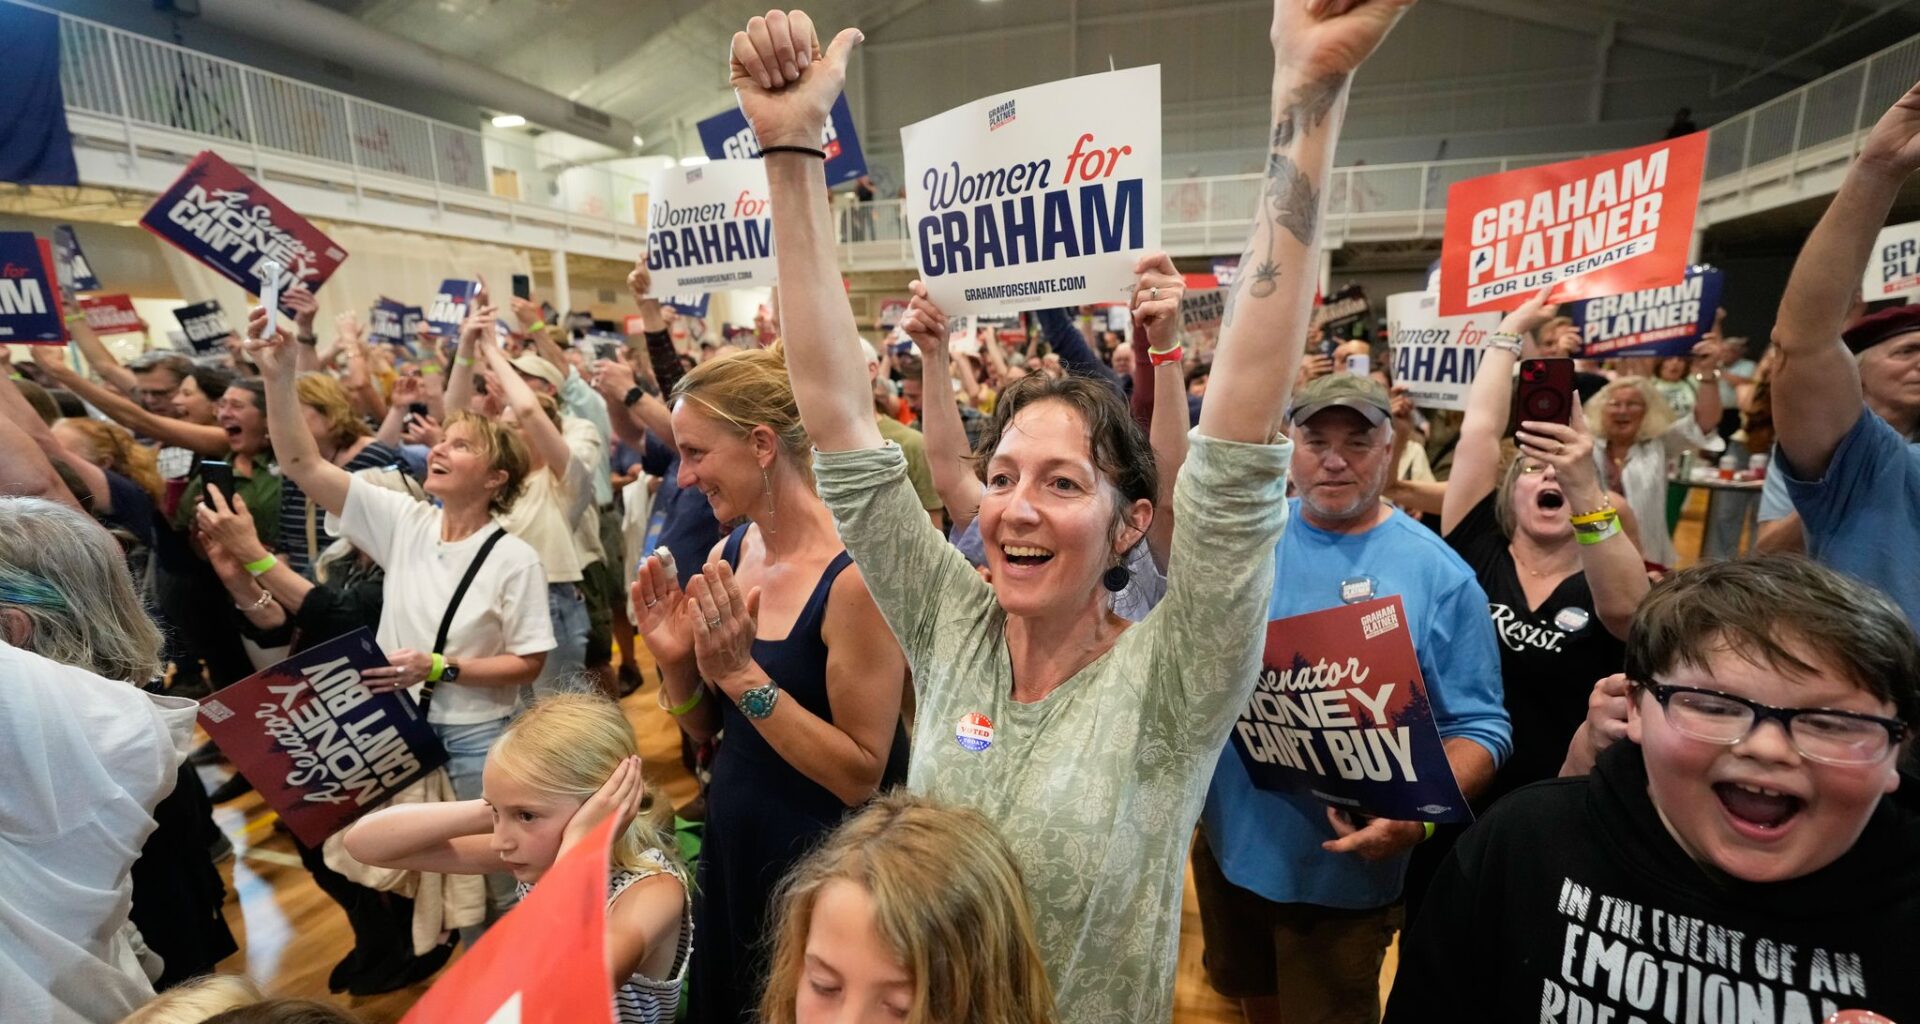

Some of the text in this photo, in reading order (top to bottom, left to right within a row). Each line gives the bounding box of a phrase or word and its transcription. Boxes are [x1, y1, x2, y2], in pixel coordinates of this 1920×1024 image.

[988, 100, 1016, 120] GRAHAM
[923, 133, 1132, 211] Women for
[1471, 147, 1670, 247] GRAHAM
[168, 199, 257, 264] CAN'T
[184, 184, 319, 282] MONEY
[652, 200, 725, 229] Women
[918, 178, 1144, 277] GRAHAM
[1468, 192, 1663, 286] PLATNER
[965, 276, 1086, 301] GRAHAMFORSENATE.COM
[1483, 242, 1637, 298] FOR U.S. SENATE
[1586, 277, 1703, 322] GRAHAM
[1456, 320, 1487, 345] for
[1584, 300, 1700, 343] PLATNER
[1361, 604, 1396, 626] GRAHAM
[1362, 613, 1399, 635] PLATNER
[1488, 603, 1566, 653] Resist.
[255, 703, 328, 786] Senator
[267, 680, 385, 807] MONEY
[300, 656, 421, 788] CAN'T BUY
[1236, 721, 1418, 782] CAN'T BUY
[1558, 877, 1866, 998] IN THE EVENT OF AN
